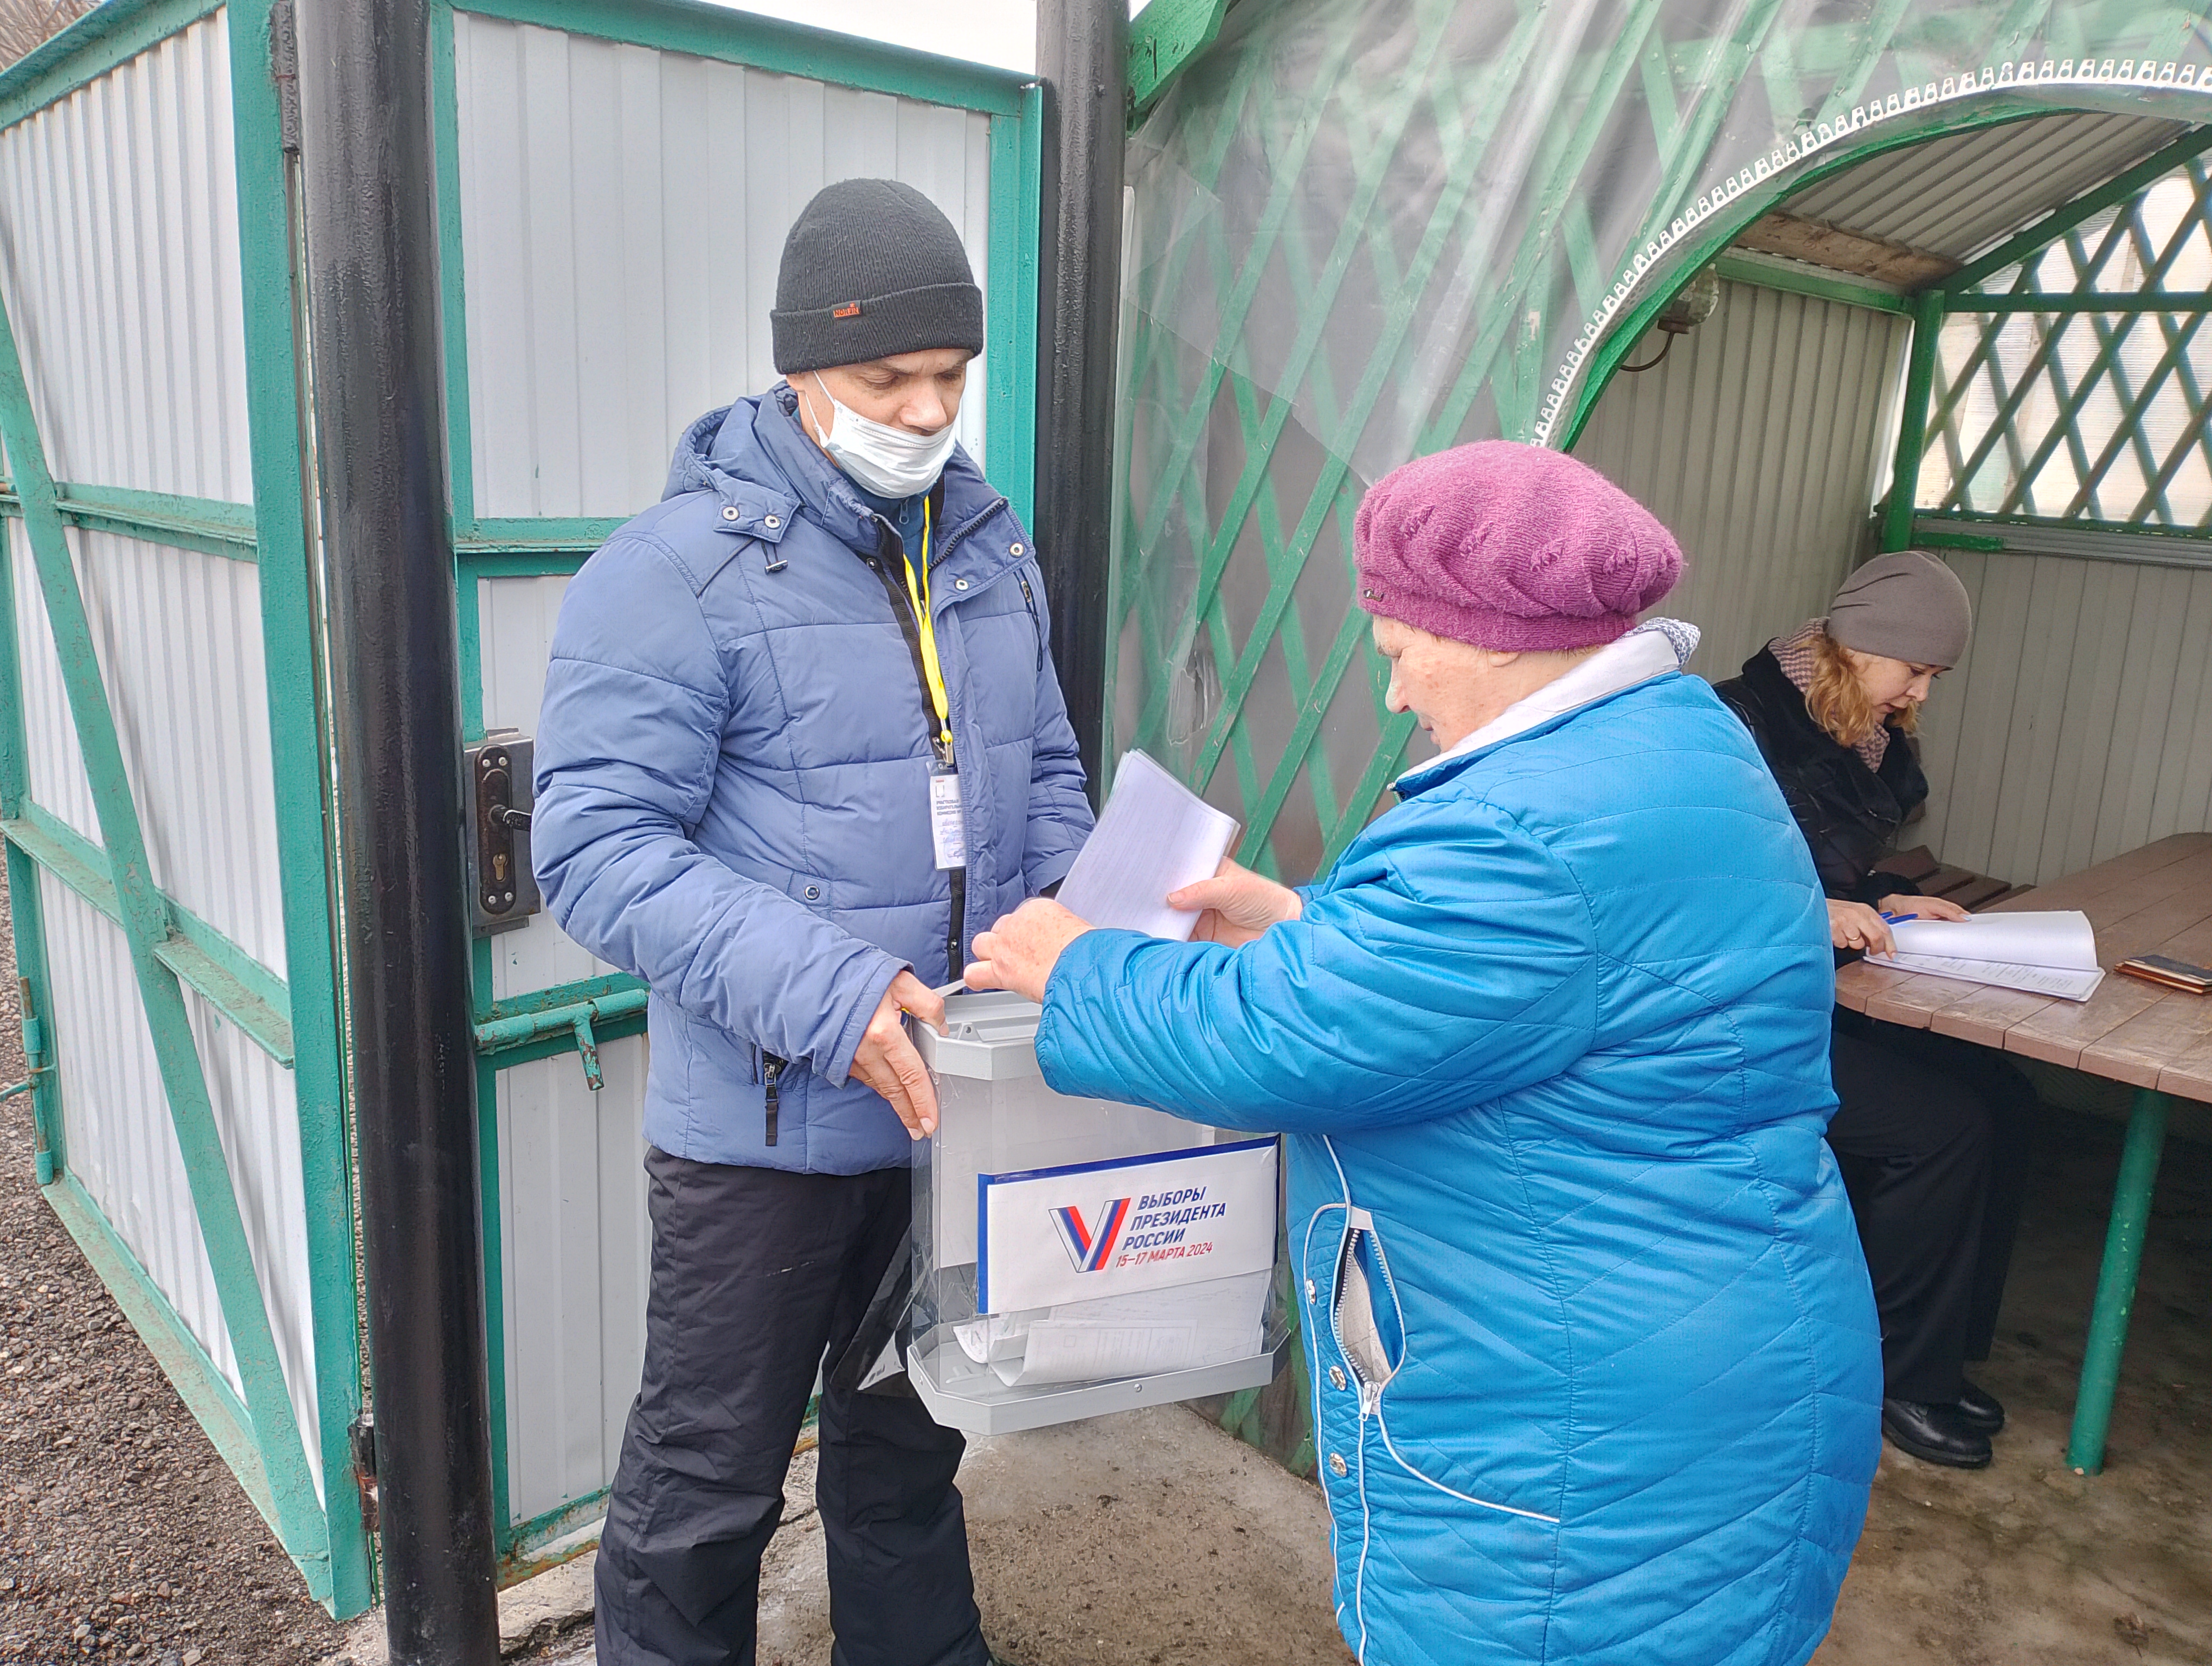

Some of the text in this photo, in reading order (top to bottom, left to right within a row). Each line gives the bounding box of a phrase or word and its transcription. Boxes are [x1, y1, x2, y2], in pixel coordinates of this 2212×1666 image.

[835, 307, 859, 316] NORFIN
[1137, 1186, 1207, 1210] ВЫБОРЫ
[1129, 1202, 1226, 1231] ПРЕЗИДЕНТА
[1122, 1227, 1186, 1251] РОССИИ
[1147, 1246, 1185, 1263] МАРТА
[1186, 1241, 1213, 1257] 2024
